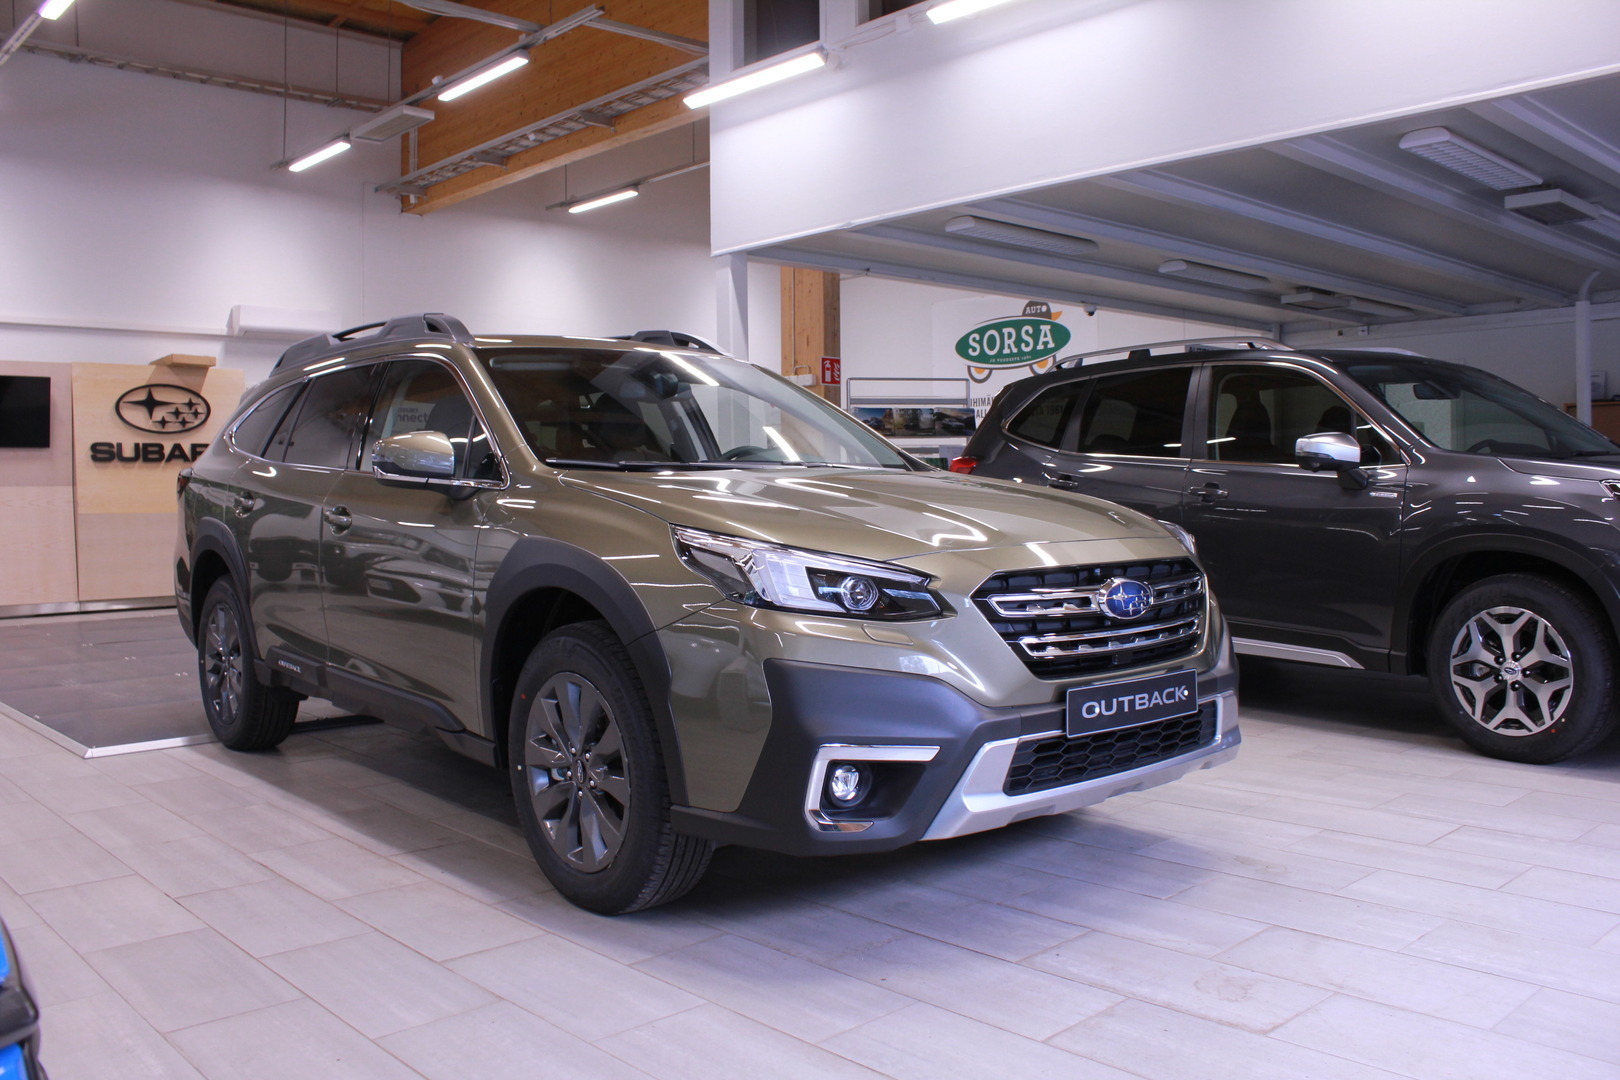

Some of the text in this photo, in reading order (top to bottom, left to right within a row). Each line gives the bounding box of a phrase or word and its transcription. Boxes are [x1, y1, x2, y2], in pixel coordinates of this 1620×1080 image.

[1025, 305, 1047, 314] AUTO
[968, 325, 1055, 356] SORSA
[970, 394, 994, 407] IHIMÄ
[1081, 685, 1187, 719] OUTBACK
